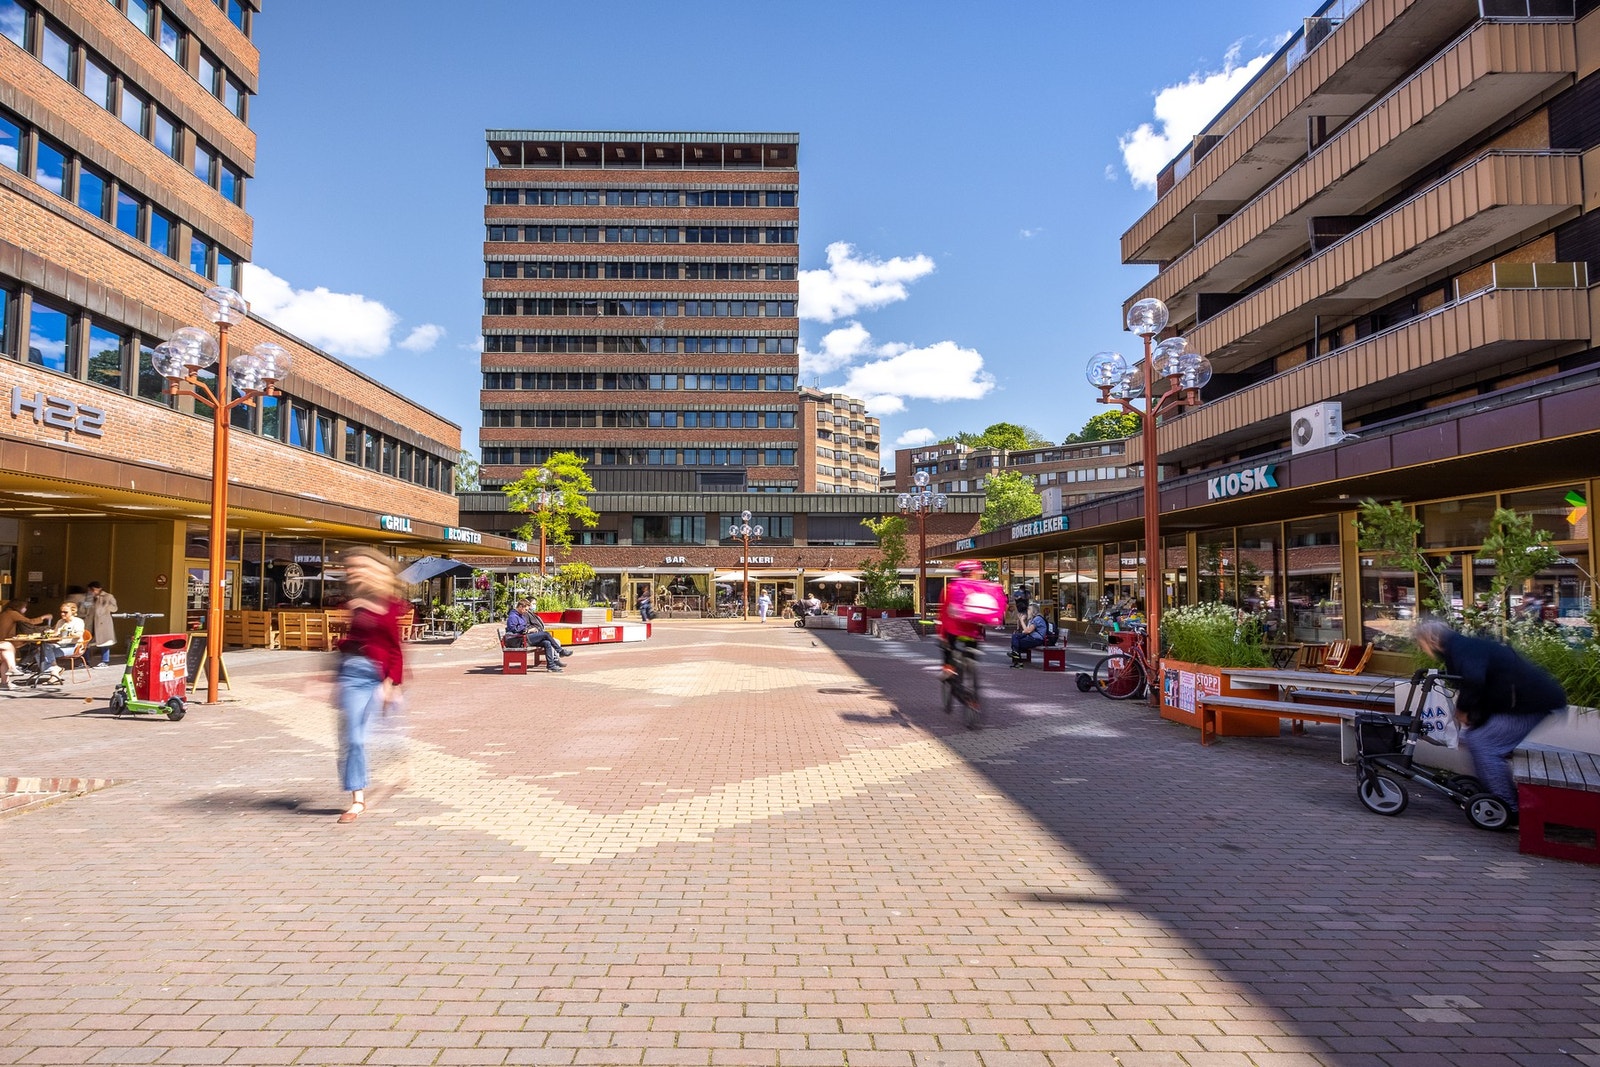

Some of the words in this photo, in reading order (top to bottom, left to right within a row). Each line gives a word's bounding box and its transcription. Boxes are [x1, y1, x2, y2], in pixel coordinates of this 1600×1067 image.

[12, 386, 106, 436] H22
[1208, 465, 1271, 499] KIOSK
[386, 515, 412, 532] GRILL
[1039, 516, 1063, 534] LEKER
[448, 527, 481, 544] BLOMSTER
[1196, 674, 1218, 688] STOPP
